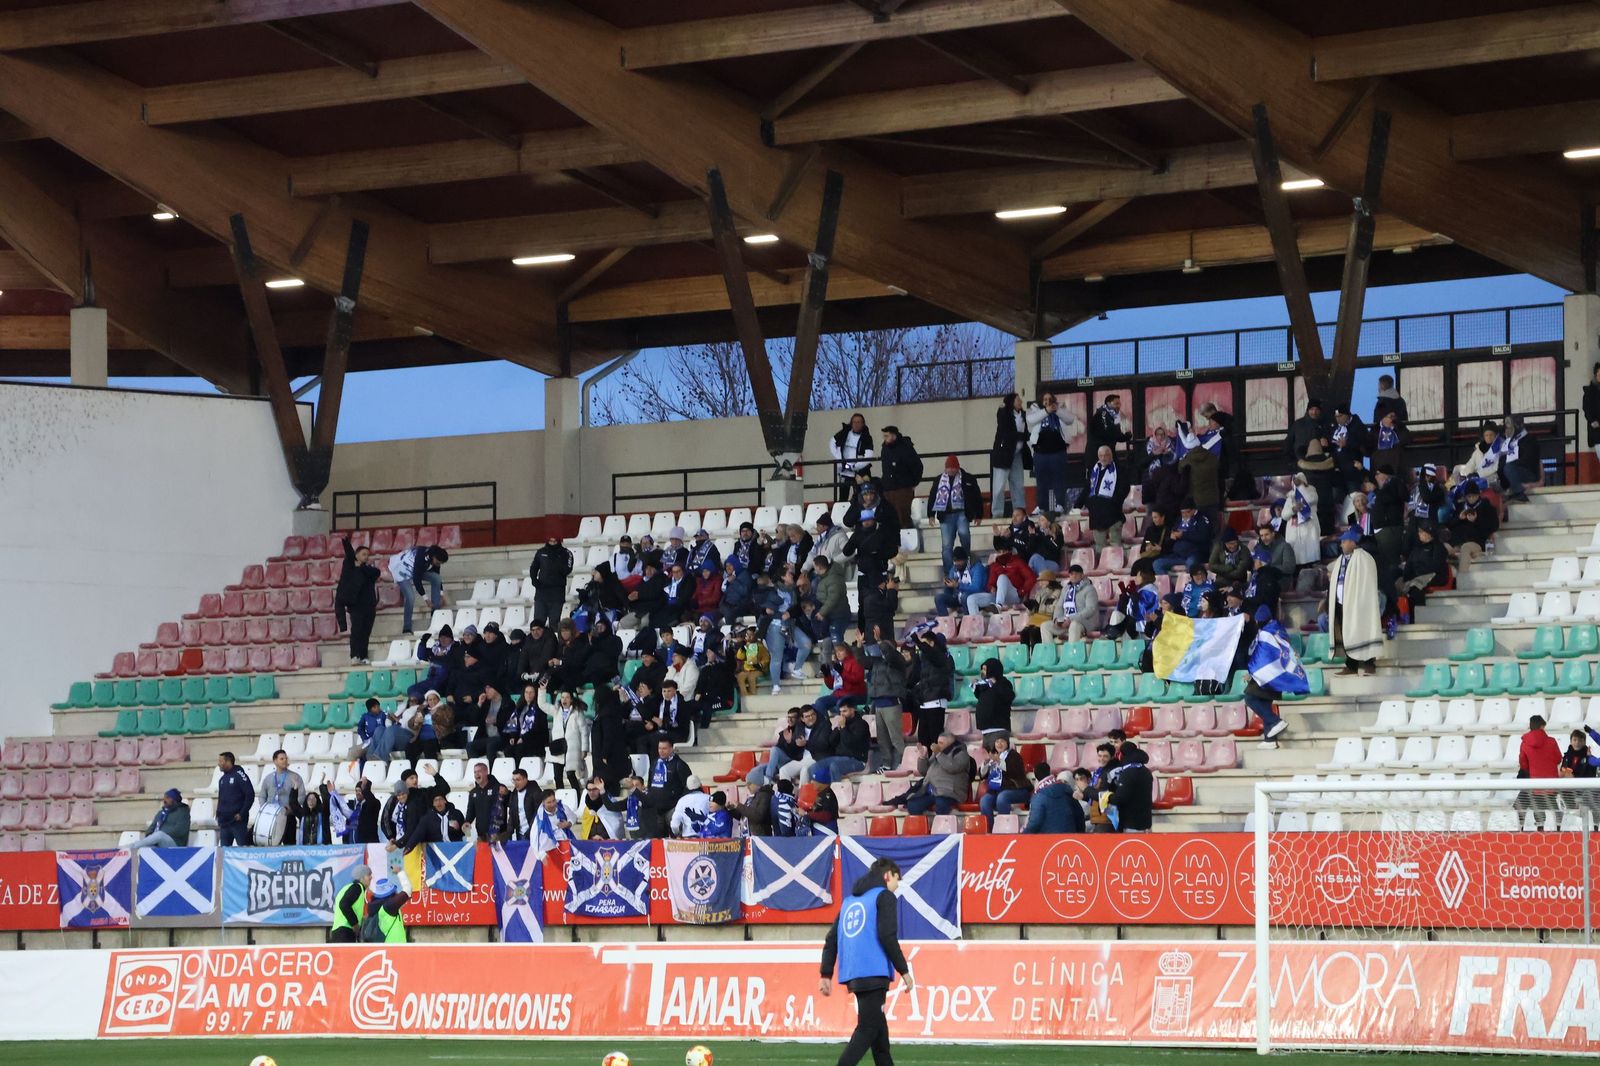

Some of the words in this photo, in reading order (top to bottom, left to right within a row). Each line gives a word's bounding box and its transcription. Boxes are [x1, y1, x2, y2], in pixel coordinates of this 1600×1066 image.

[1057, 854, 1083, 868] IM
[1121, 854, 1147, 868] IM
[1185, 854, 1212, 868] IM
[1315, 874, 1361, 883] NISSAN
[1499, 862, 1540, 881] Grupo
[18, 884, 43, 905] DE
[249, 871, 334, 912] IBÉRICA
[1054, 889, 1087, 904] TES
[1118, 890, 1151, 904] TES
[1182, 890, 1216, 905] TES
[1374, 888, 1421, 897] DACIA
[1500, 880, 1585, 900] Leomotor
[427, 909, 470, 922] Flowers
[183, 952, 255, 979] ONDA
[259, 950, 334, 977] CERO
[1012, 956, 1125, 986] CLÍNICA
[124, 973, 168, 989] ONDA
[1212, 951, 1421, 1009] ZAMORA
[177, 981, 329, 1009] ZAMORA
[887, 946, 998, 1036] Ápex
[1448, 955, 1600, 1041] FRA
[122, 999, 165, 1016] CERO
[783, 994, 822, 1027] S.A.
[1011, 997, 1120, 1022] DENTAL
[204, 1010, 254, 1032] 99.7
[261, 1010, 295, 1031] FM
